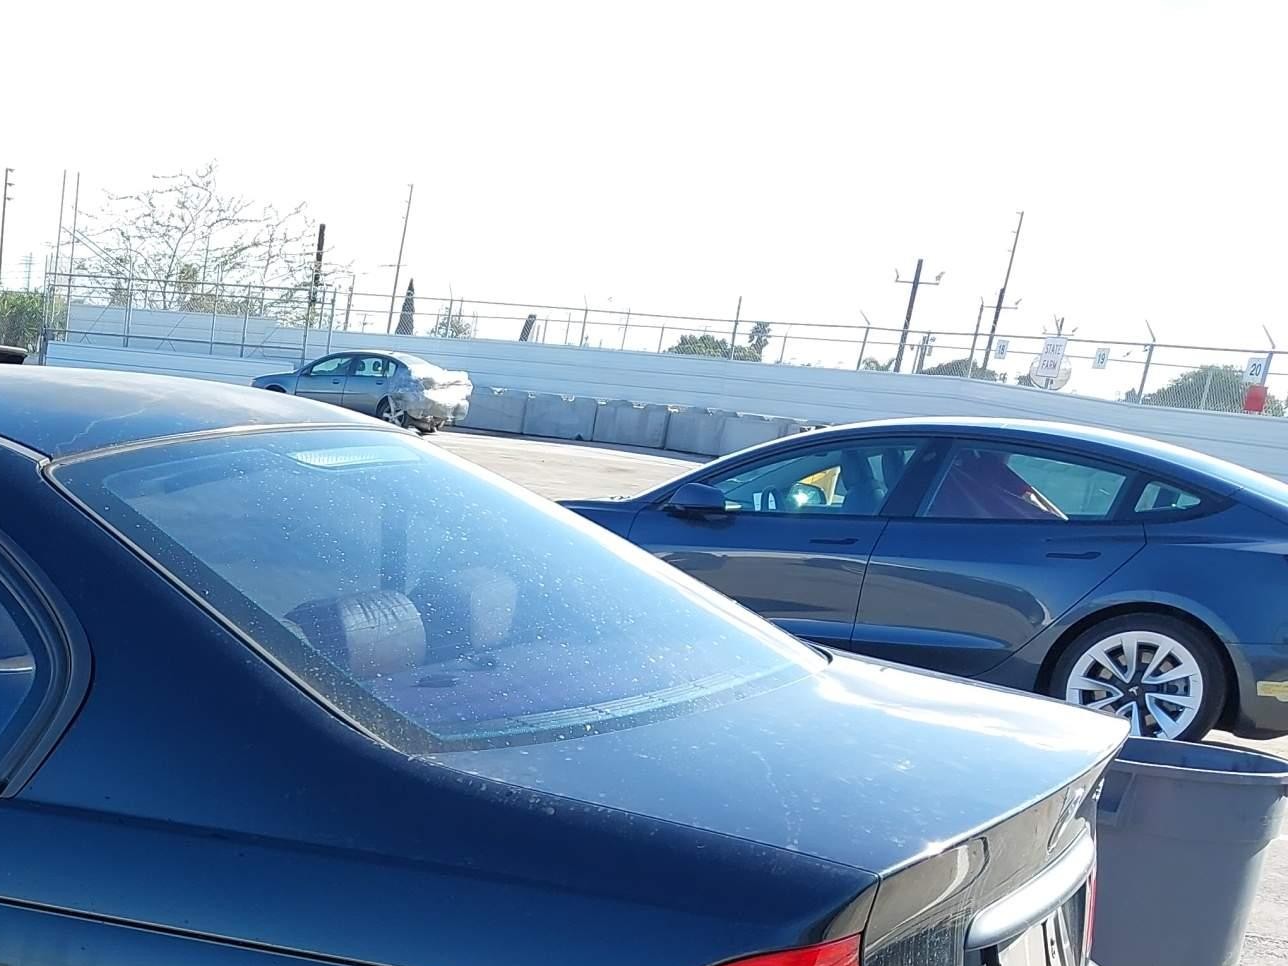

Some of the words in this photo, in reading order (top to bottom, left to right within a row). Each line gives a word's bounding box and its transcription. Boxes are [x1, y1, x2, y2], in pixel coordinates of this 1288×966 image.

[1044, 343, 1063, 355] STATE
[1041, 359, 1058, 369] FARM
[1098, 353, 1106, 364] 19
[1249, 363, 1261, 376] 20
